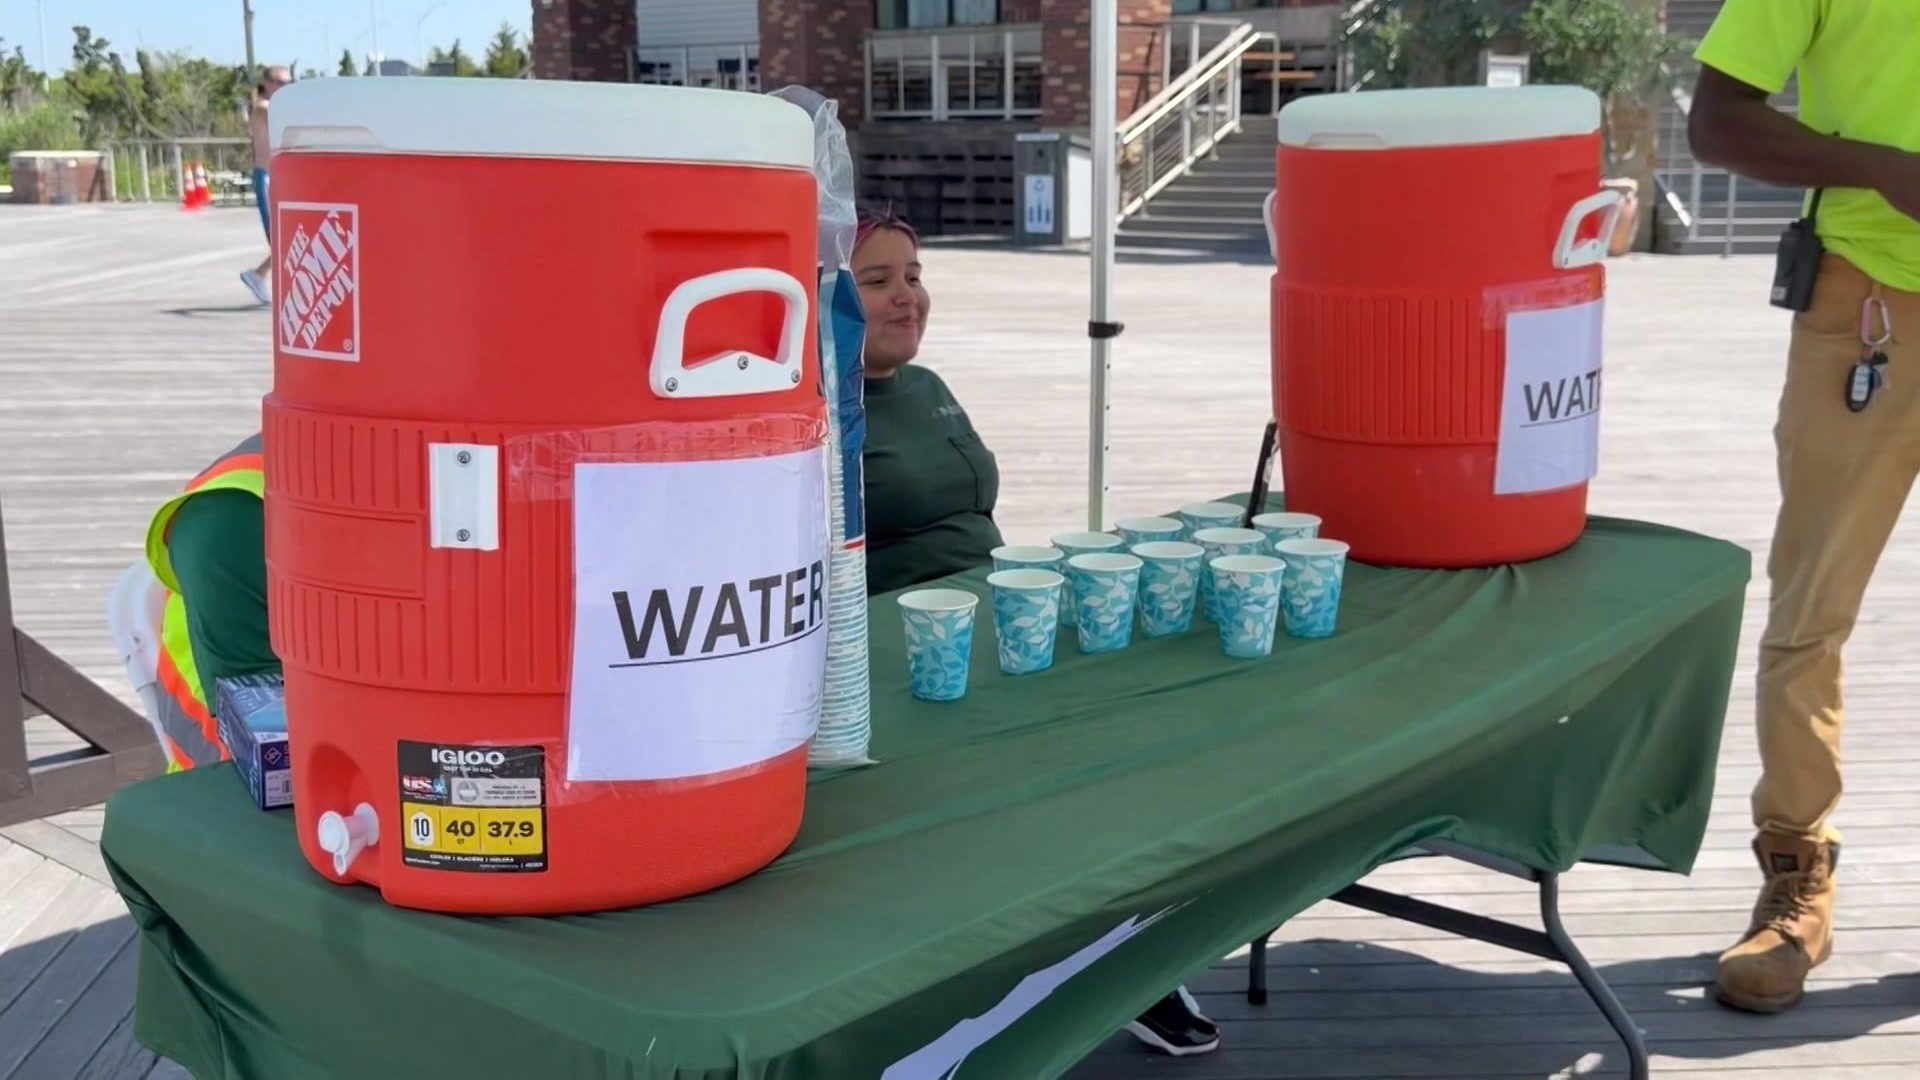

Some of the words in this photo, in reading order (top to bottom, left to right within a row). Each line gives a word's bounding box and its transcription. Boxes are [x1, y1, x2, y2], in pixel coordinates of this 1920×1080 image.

[282, 210, 354, 348] HOME
[284, 223, 310, 278] THE
[300, 264, 353, 350] DEPOT
[612, 559, 824, 660] WATER
[431, 748, 505, 765] IGLOO
[413, 817, 430, 837] 10
[446, 820, 475, 837] 40
[487, 821, 534, 837] 37.9
